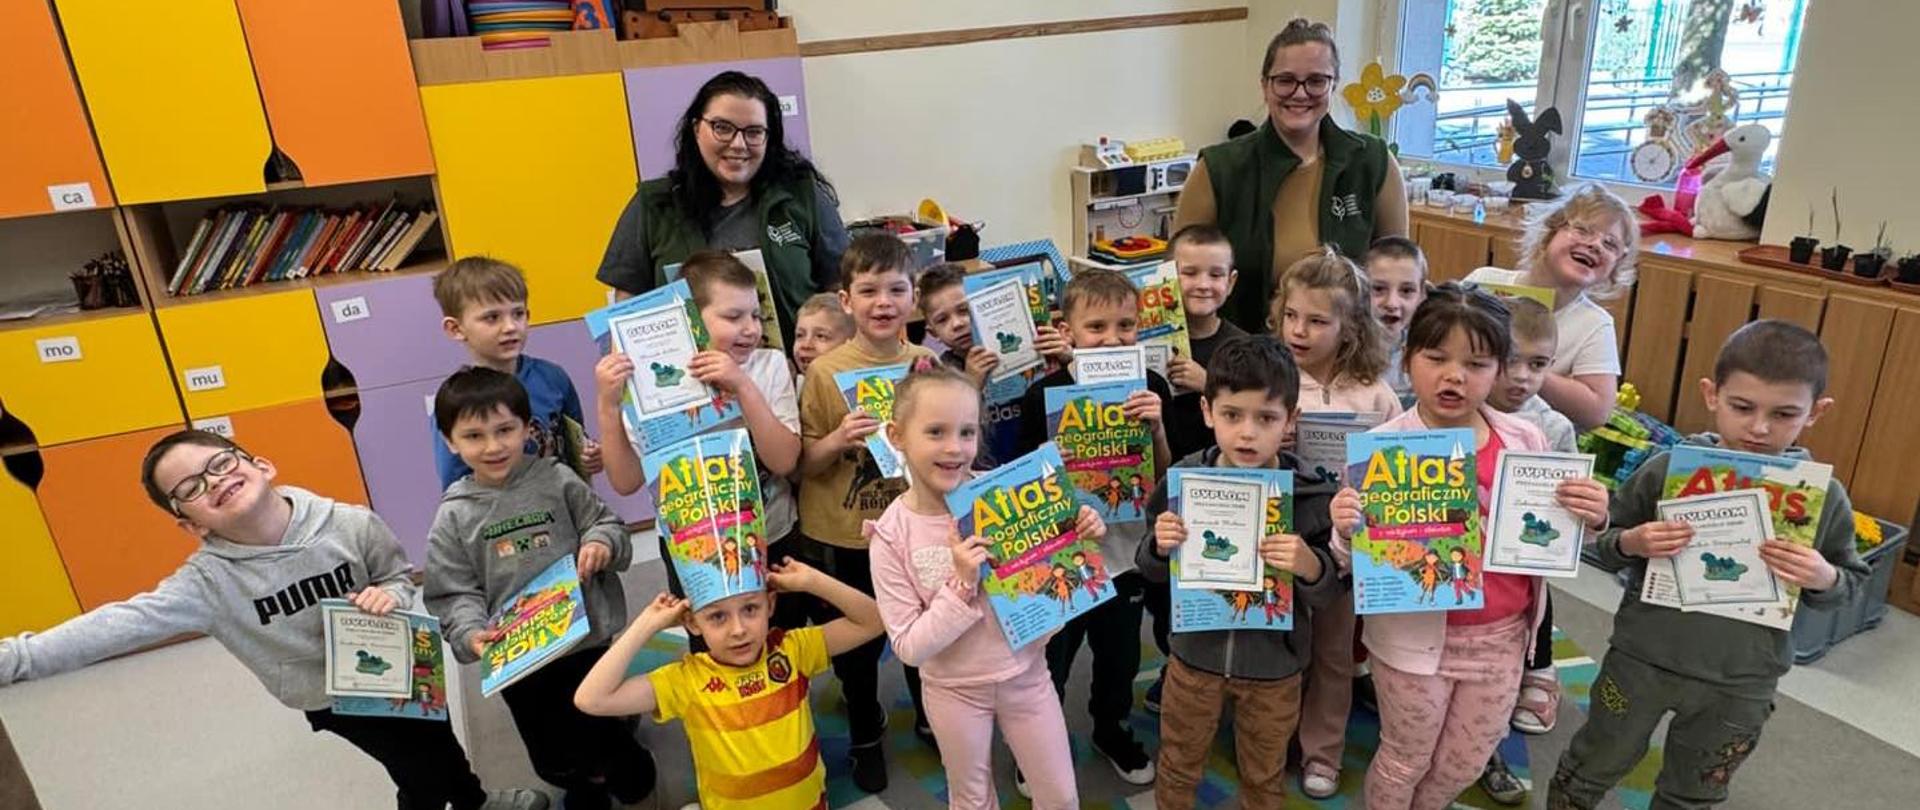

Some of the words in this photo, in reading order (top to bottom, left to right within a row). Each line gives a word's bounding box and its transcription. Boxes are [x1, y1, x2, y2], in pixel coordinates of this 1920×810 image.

[62, 190, 84, 205] ca
[1136, 286, 1174, 312] las
[341, 302, 361, 317] da
[44, 342, 74, 358] mo
[191, 374, 218, 387] mu
[1055, 426, 1146, 445] geograficzny
[1304, 430, 1346, 441] DYPLO
[1076, 440, 1128, 459] Polski
[659, 456, 746, 502] Atlas
[1361, 449, 1466, 490] Atlas
[1514, 466, 1578, 480] DYPLOM
[1190, 488, 1250, 502] DYPLOM
[1359, 486, 1471, 508] geograficzny
[680, 494, 739, 526] Polski
[973, 474, 1063, 538] Atlas
[1384, 503, 1448, 524] Polski
[1674, 506, 1748, 523] DYPLOM
[994, 497, 1072, 540] ograficzny
[1001, 517, 1059, 560] Polski
[253, 561, 355, 626] PUMA
